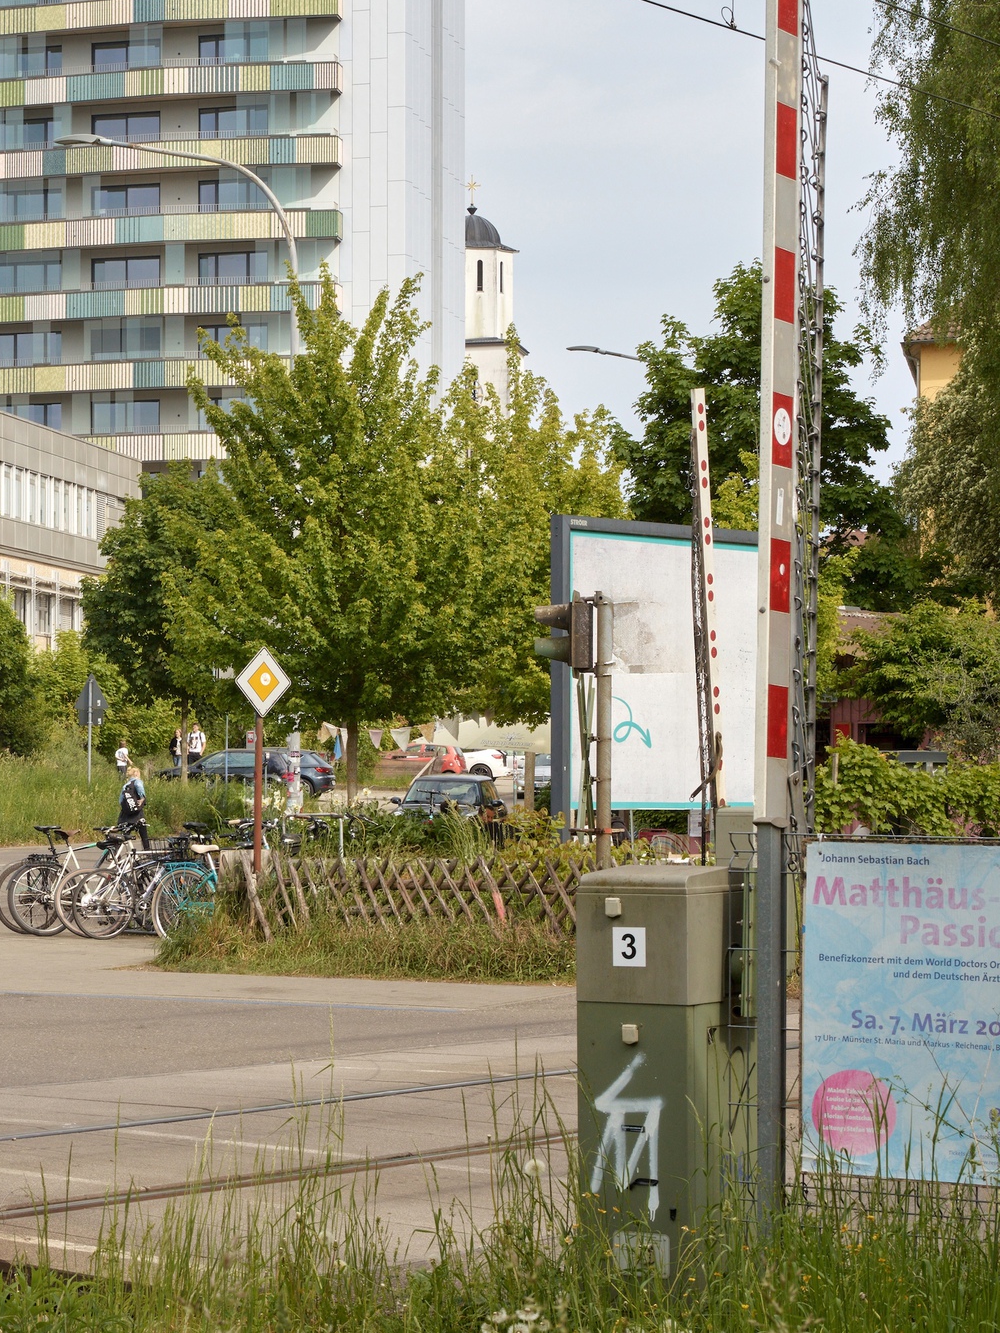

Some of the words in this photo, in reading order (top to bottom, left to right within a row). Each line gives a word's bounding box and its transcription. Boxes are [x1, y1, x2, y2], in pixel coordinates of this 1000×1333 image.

[570, 518, 588, 526] STRÖER
[821, 854, 856, 864] Johann
[858, 855, 904, 865] Sebastian
[906, 856, 930, 866] Bach
[812, 876, 1000, 911] Matthäus-
[621, 933, 637, 960] 3
[818, 953, 884, 964] Benefizkonzert
[886, 955, 902, 965] mit
[904, 956, 923, 966] dem
[925, 958, 952, 967] World
[954, 958, 988, 969] Doctors
[893, 970, 910, 979] und
[912, 970, 932, 980] dem
[934, 971, 980, 982] Deutschen
[851, 1009, 883, 1030] Sa.
[889, 1015, 905, 1035] 7.
[911, 1012, 969, 1035] März
[814, 1035, 822, 1043] 17
[823, 1034, 837, 1042] Uhr
[842, 1035, 872, 1044] Münster
[874, 1036, 884, 1045] St.
[885, 1037, 905, 1046] Maria
[907, 1039, 921, 1047] und
[922, 1040, 950, 1048] Markus
